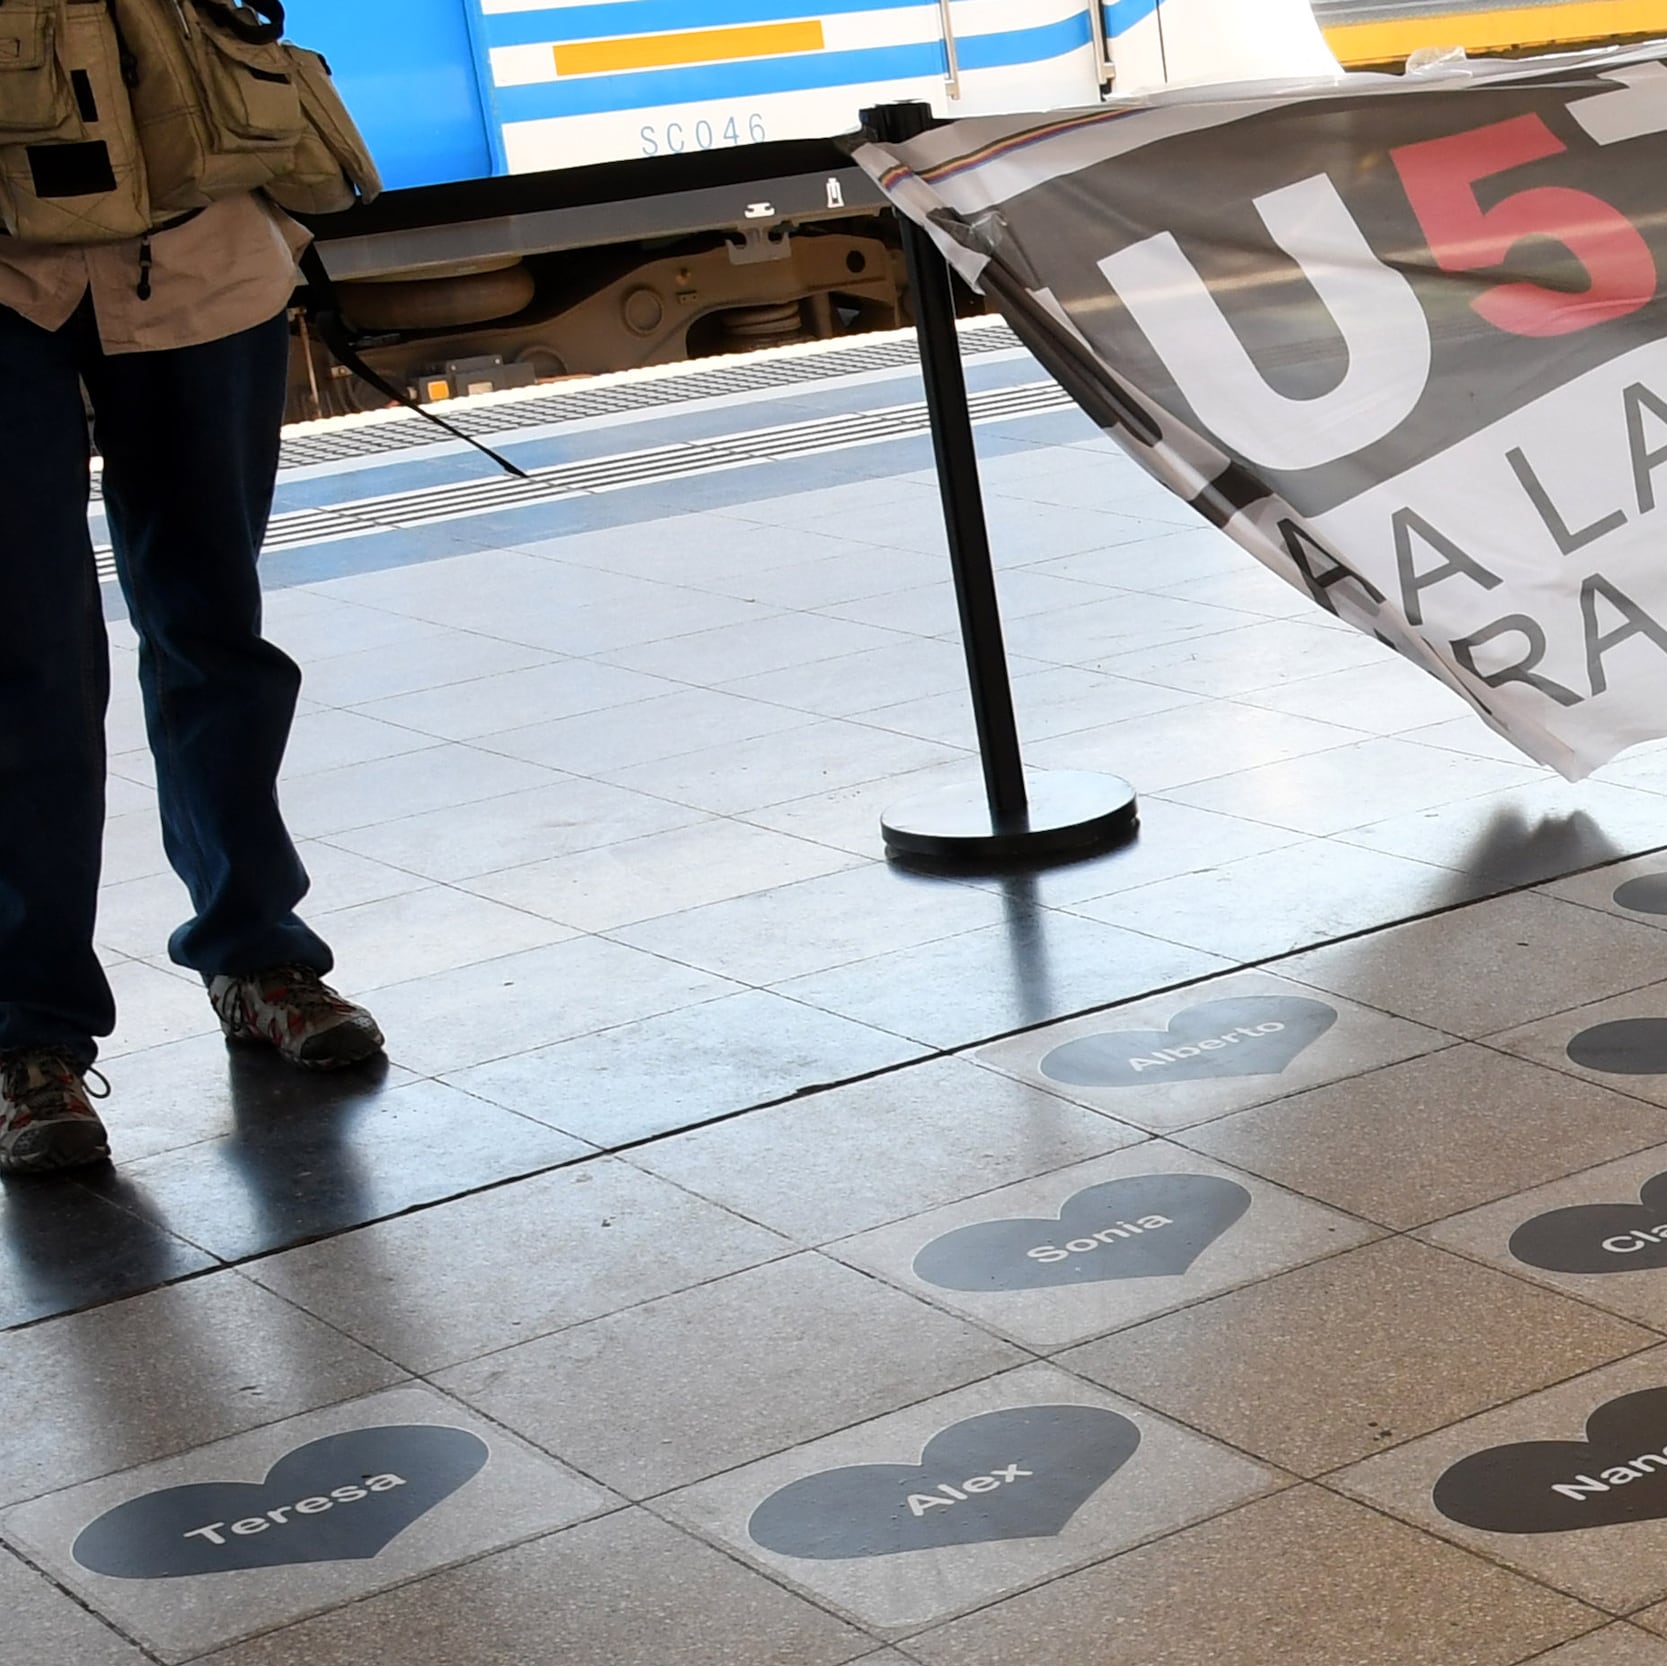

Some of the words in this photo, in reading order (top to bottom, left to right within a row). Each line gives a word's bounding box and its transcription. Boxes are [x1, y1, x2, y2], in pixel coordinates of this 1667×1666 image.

[640, 113, 766, 156] SC046
[1128, 1020, 1286, 1073] Alberto
[1026, 1210, 1174, 1264] Sonia
[182, 1470, 408, 1548] Teresa
[906, 1458, 1034, 1518] Alex
